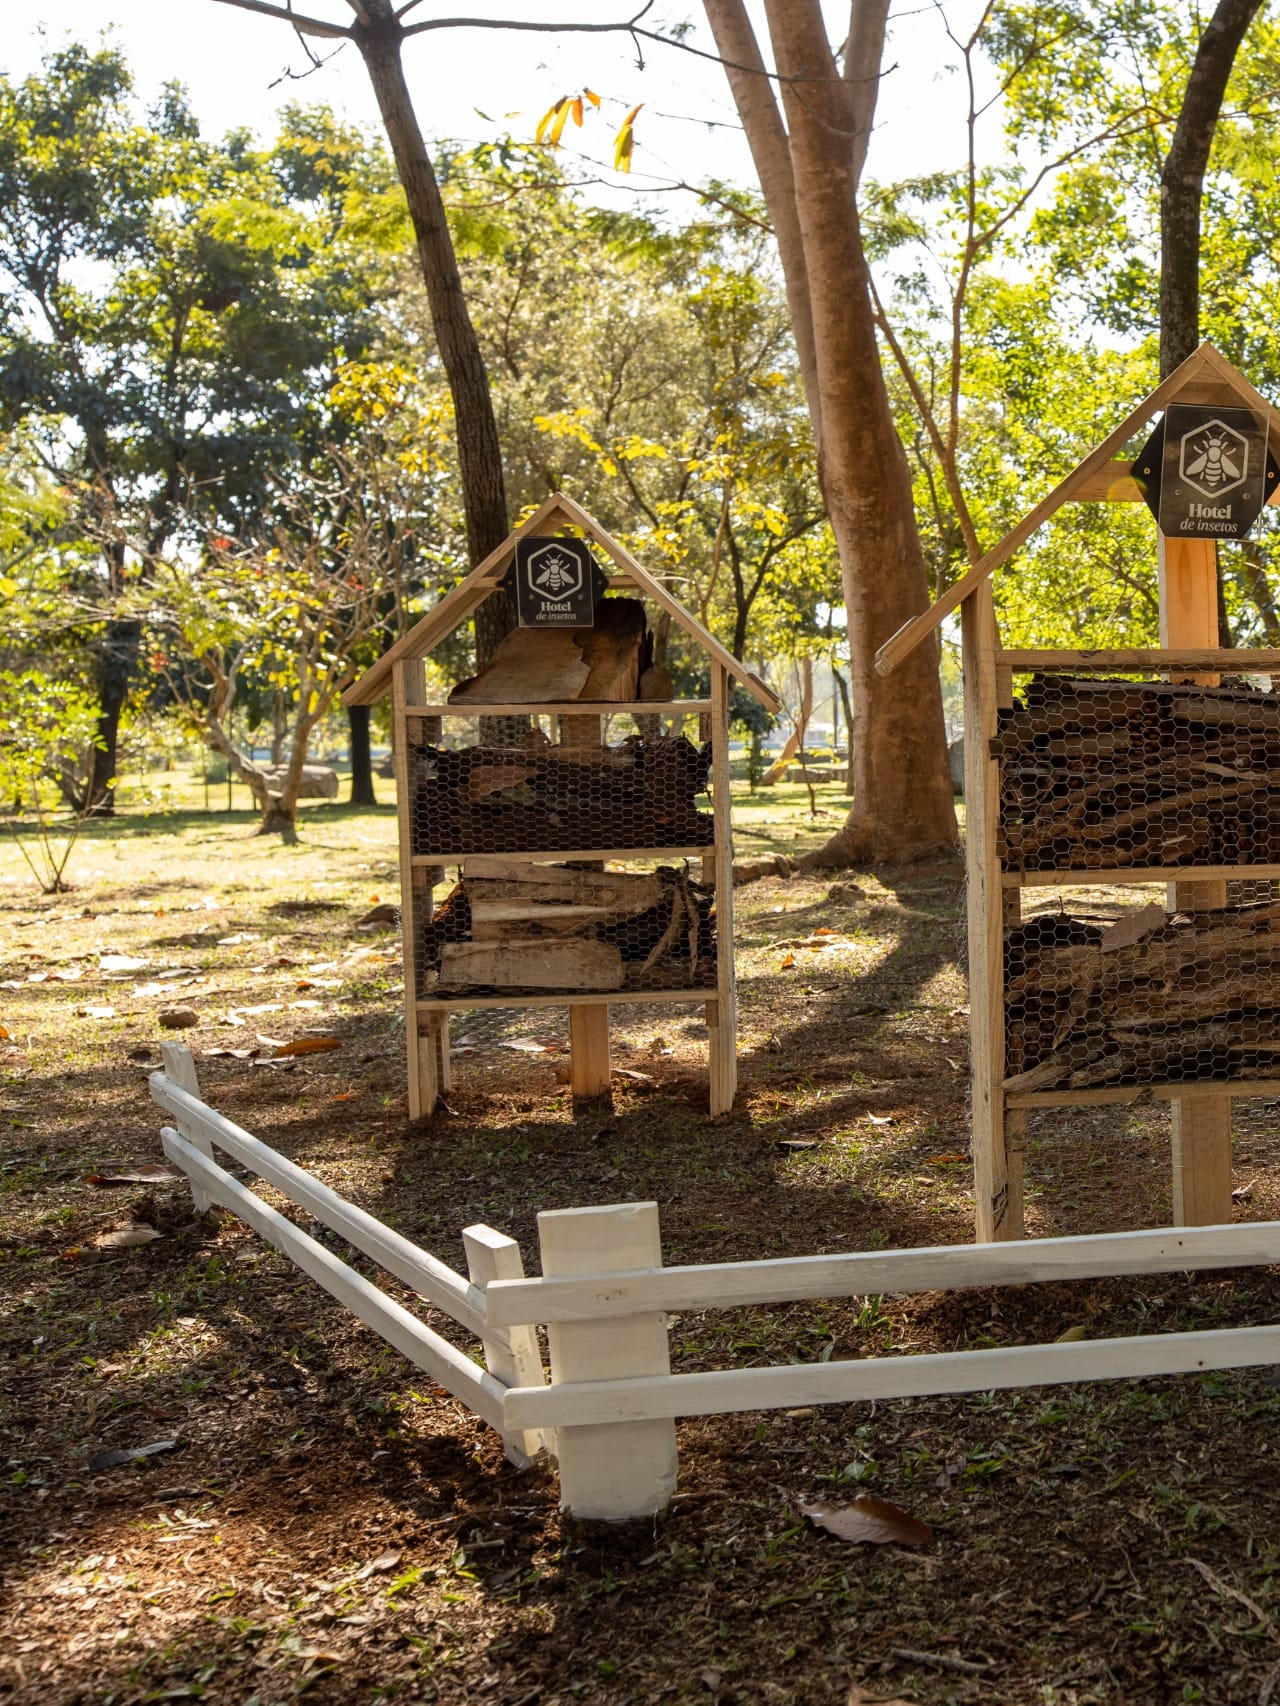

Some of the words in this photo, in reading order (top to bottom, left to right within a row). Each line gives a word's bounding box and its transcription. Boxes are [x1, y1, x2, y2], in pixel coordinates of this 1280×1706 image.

[1189, 504, 1232, 519] Hotel
[1180, 518, 1194, 530] de
[1197, 519, 1238, 533] insetos
[541, 601, 571, 611] Hotel
[536, 612, 546, 620] de
[548, 612, 576, 620] insetos
